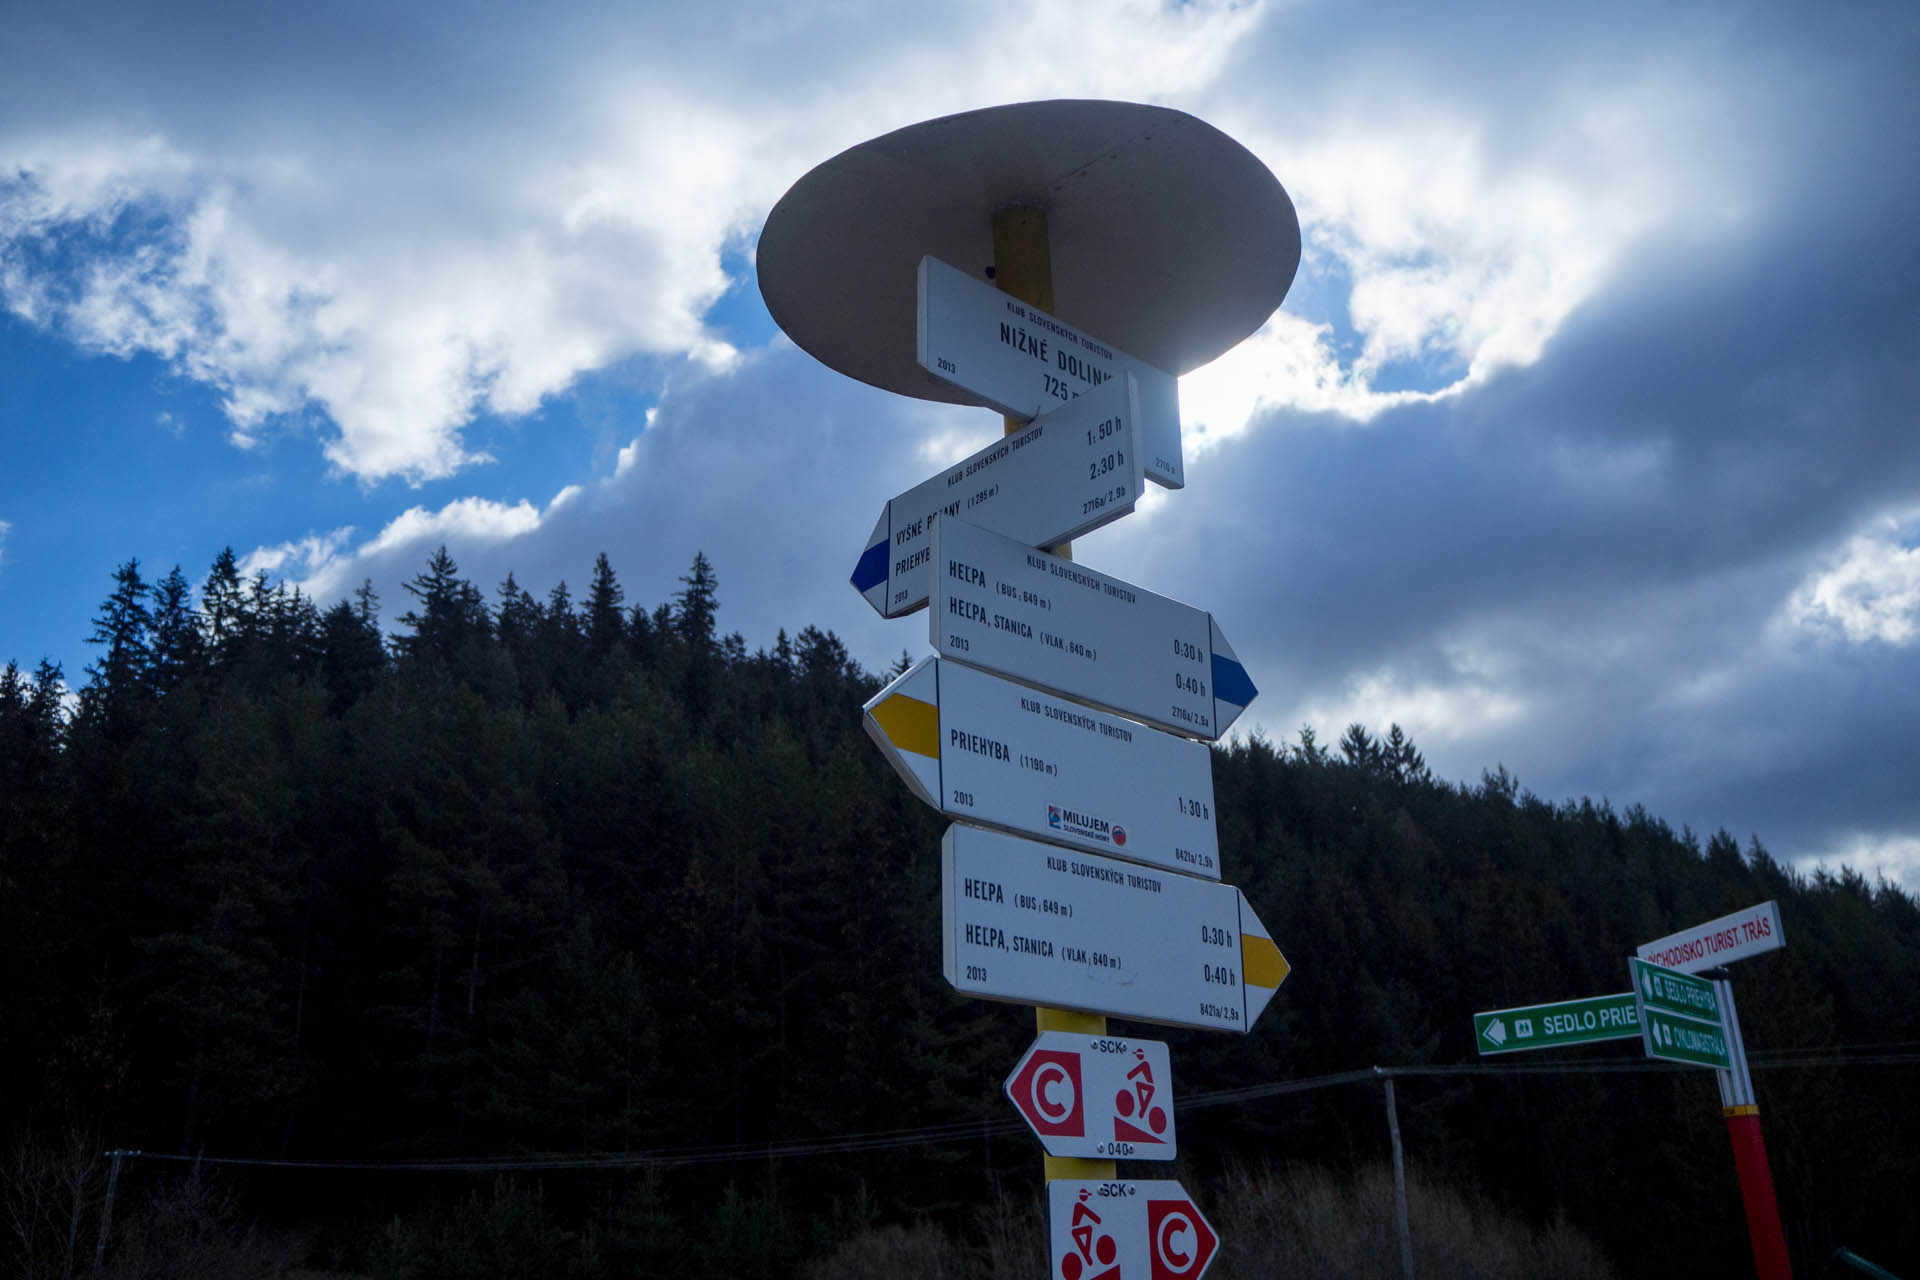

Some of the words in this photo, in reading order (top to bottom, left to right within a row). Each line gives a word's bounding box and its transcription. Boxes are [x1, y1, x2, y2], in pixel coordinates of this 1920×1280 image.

[1000, 322, 1048, 362] NIŽNÉ
[1007, 302, 1025, 317] KLUB
[1029, 312, 1078, 345] SLOVENSKÝCH
[1081, 336, 1113, 361] TURISTOV
[937, 357, 956, 374] 2013
[1043, 374, 1068, 401] 725
[1115, 416, 1122, 431] h
[947, 470, 963, 488] KLUB
[966, 445, 1009, 479] SLOVENSKÝCH
[1012, 426, 1043, 451] TURISTOV
[1090, 454, 1115, 480] 2:30
[1117, 451, 1124, 466] h
[896, 517, 923, 546] VYŠNÉ
[928, 500, 960, 530] PANY
[949, 560, 986, 588] HEĽPA
[1023, 588, 1038, 605] 649
[1027, 554, 1046, 571] KLUB
[1050, 564, 1100, 591] SLOVENSKÝCH
[1104, 583, 1136, 603] TURISTOV
[894, 589, 908, 604] 2013
[950, 635, 969, 651] 2013
[994, 614, 1032, 640] STANICA
[1069, 641, 1084, 658] 640
[1174, 639, 1195, 662] 0:30
[1197, 647, 1203, 664] h
[1176, 673, 1198, 695] 0:40
[1200, 680, 1206, 697] h
[1021, 698, 1041, 714] KLUB
[1045, 705, 1096, 732] SLOVENSKÝCH
[1099, 723, 1132, 743] TURISTOV
[951, 729, 1010, 762] PRIEHYBA
[954, 790, 974, 807] 2013
[1202, 804, 1209, 820] h
[1063, 810, 1109, 834] MILUJEM
[1047, 856, 1067, 873] KLUB
[1071, 863, 1124, 886] SLOVENSKÝCH
[1128, 874, 1161, 893] TURISTOV
[965, 877, 1003, 904] HEĽPA
[1043, 899, 1058, 916] 649
[1202, 925, 1224, 946] 0:30
[1226, 931, 1232, 948] h
[1645, 941, 1704, 968] CHODISKO
[1704, 927, 1742, 955] TURIST.
[1742, 915, 1771, 943] TRÁS
[1013, 936, 1054, 958] STANICA
[1092, 953, 1108, 969] 640
[966, 965, 987, 982] 2013
[1204, 964, 1227, 985] 0:40
[1229, 969, 1235, 986] h
[1543, 1011, 1596, 1035] SEDLO
[1600, 1005, 1640, 1028] PRIE
[1100, 1040, 1123, 1054] SCK
[1108, 1142, 1128, 1156] 040
[1102, 1184, 1127, 1197] SCK
